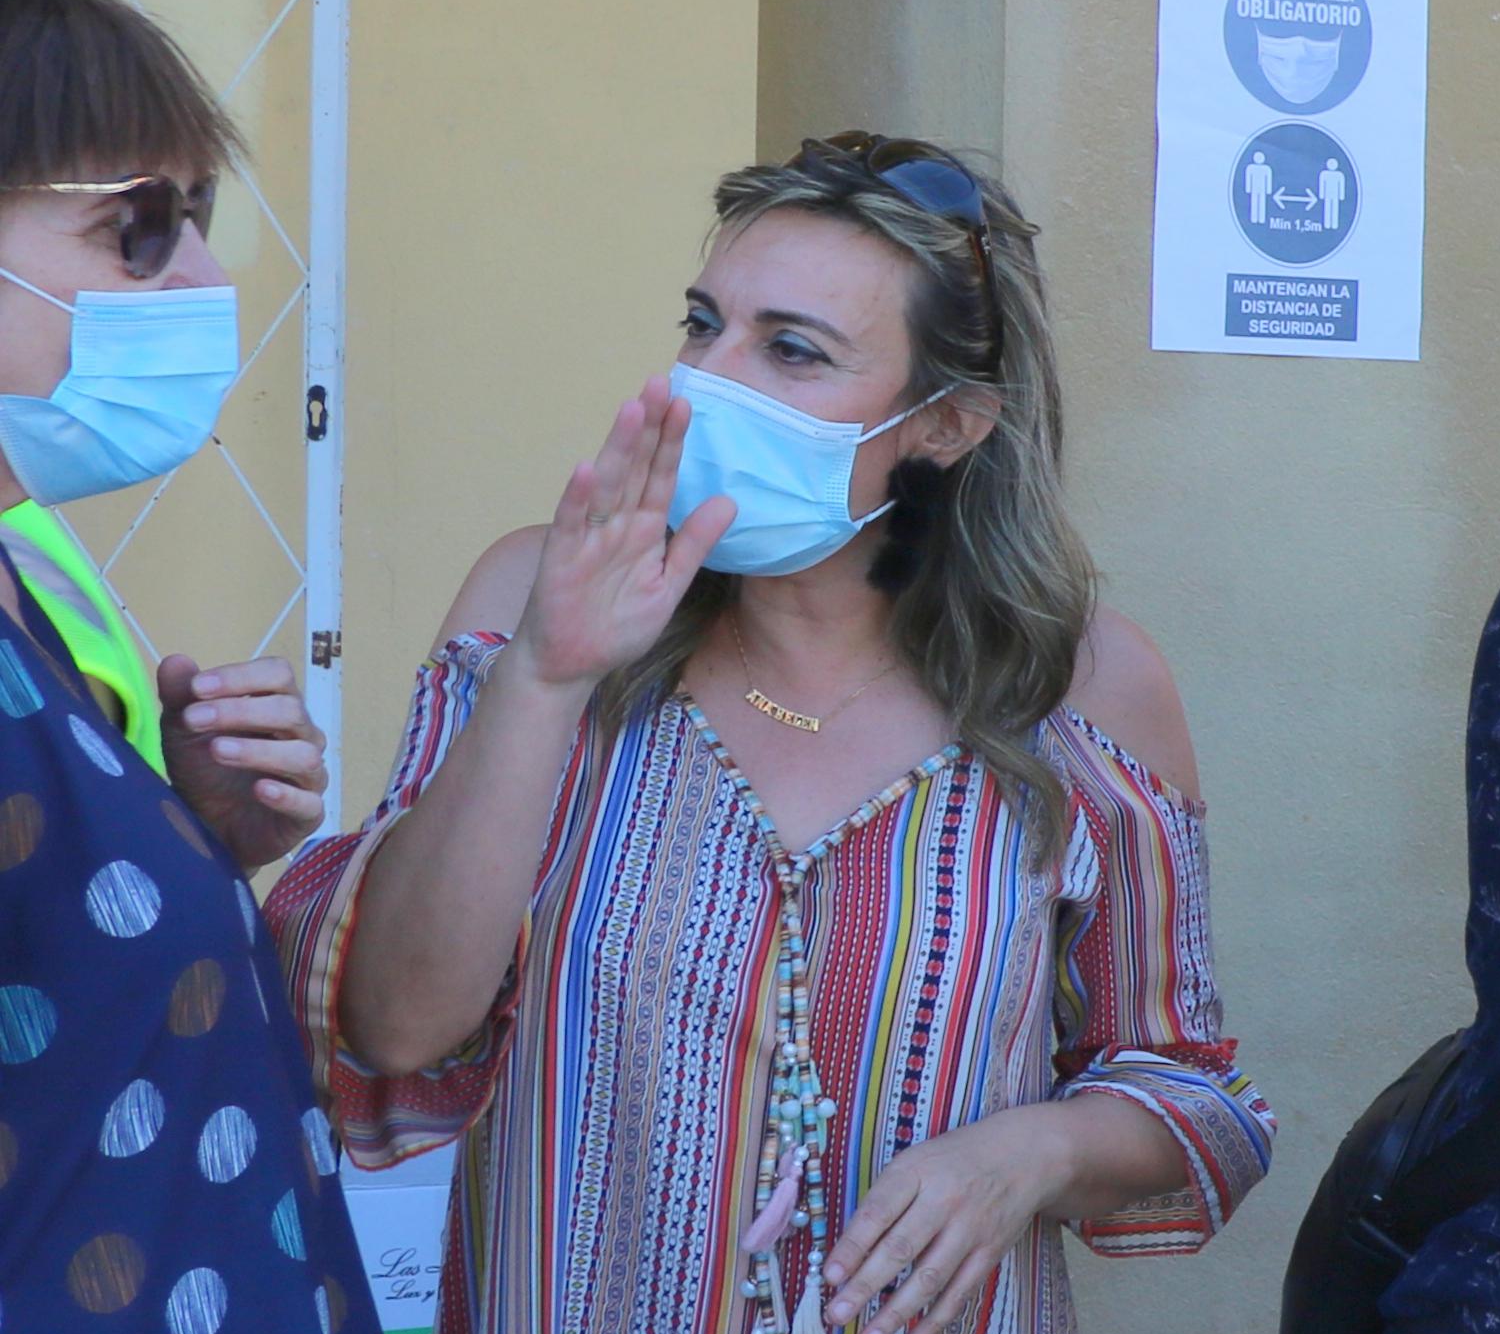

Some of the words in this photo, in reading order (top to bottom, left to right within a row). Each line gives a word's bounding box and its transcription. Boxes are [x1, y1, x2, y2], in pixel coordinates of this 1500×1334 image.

[1269, 217, 1291, 230] Min
[1294, 219, 1322, 233] 1,5m
[1233, 279, 1328, 298] MANTENGAN
[1330, 284, 1350, 299] LA
[1240, 299, 1319, 317] DISTANCIA
[1321, 303, 1342, 318] DE
[1248, 319, 1336, 337] SEGURIDAD
[371, 1247, 421, 1278] Las
